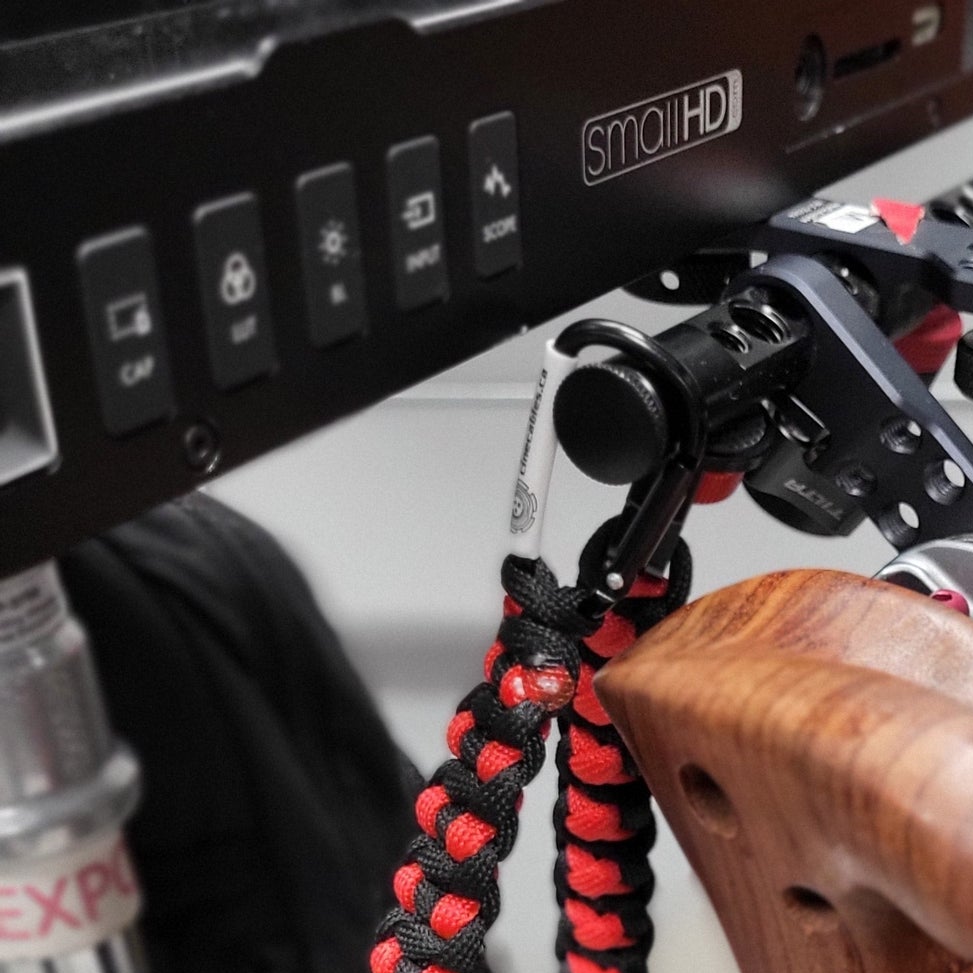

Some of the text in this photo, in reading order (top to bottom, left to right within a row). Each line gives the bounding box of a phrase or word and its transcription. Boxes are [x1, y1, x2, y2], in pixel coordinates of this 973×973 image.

[588, 84, 727, 176] smallHD
[483, 215, 517, 242] SCOPE
[120, 356, 154, 387] CAP
